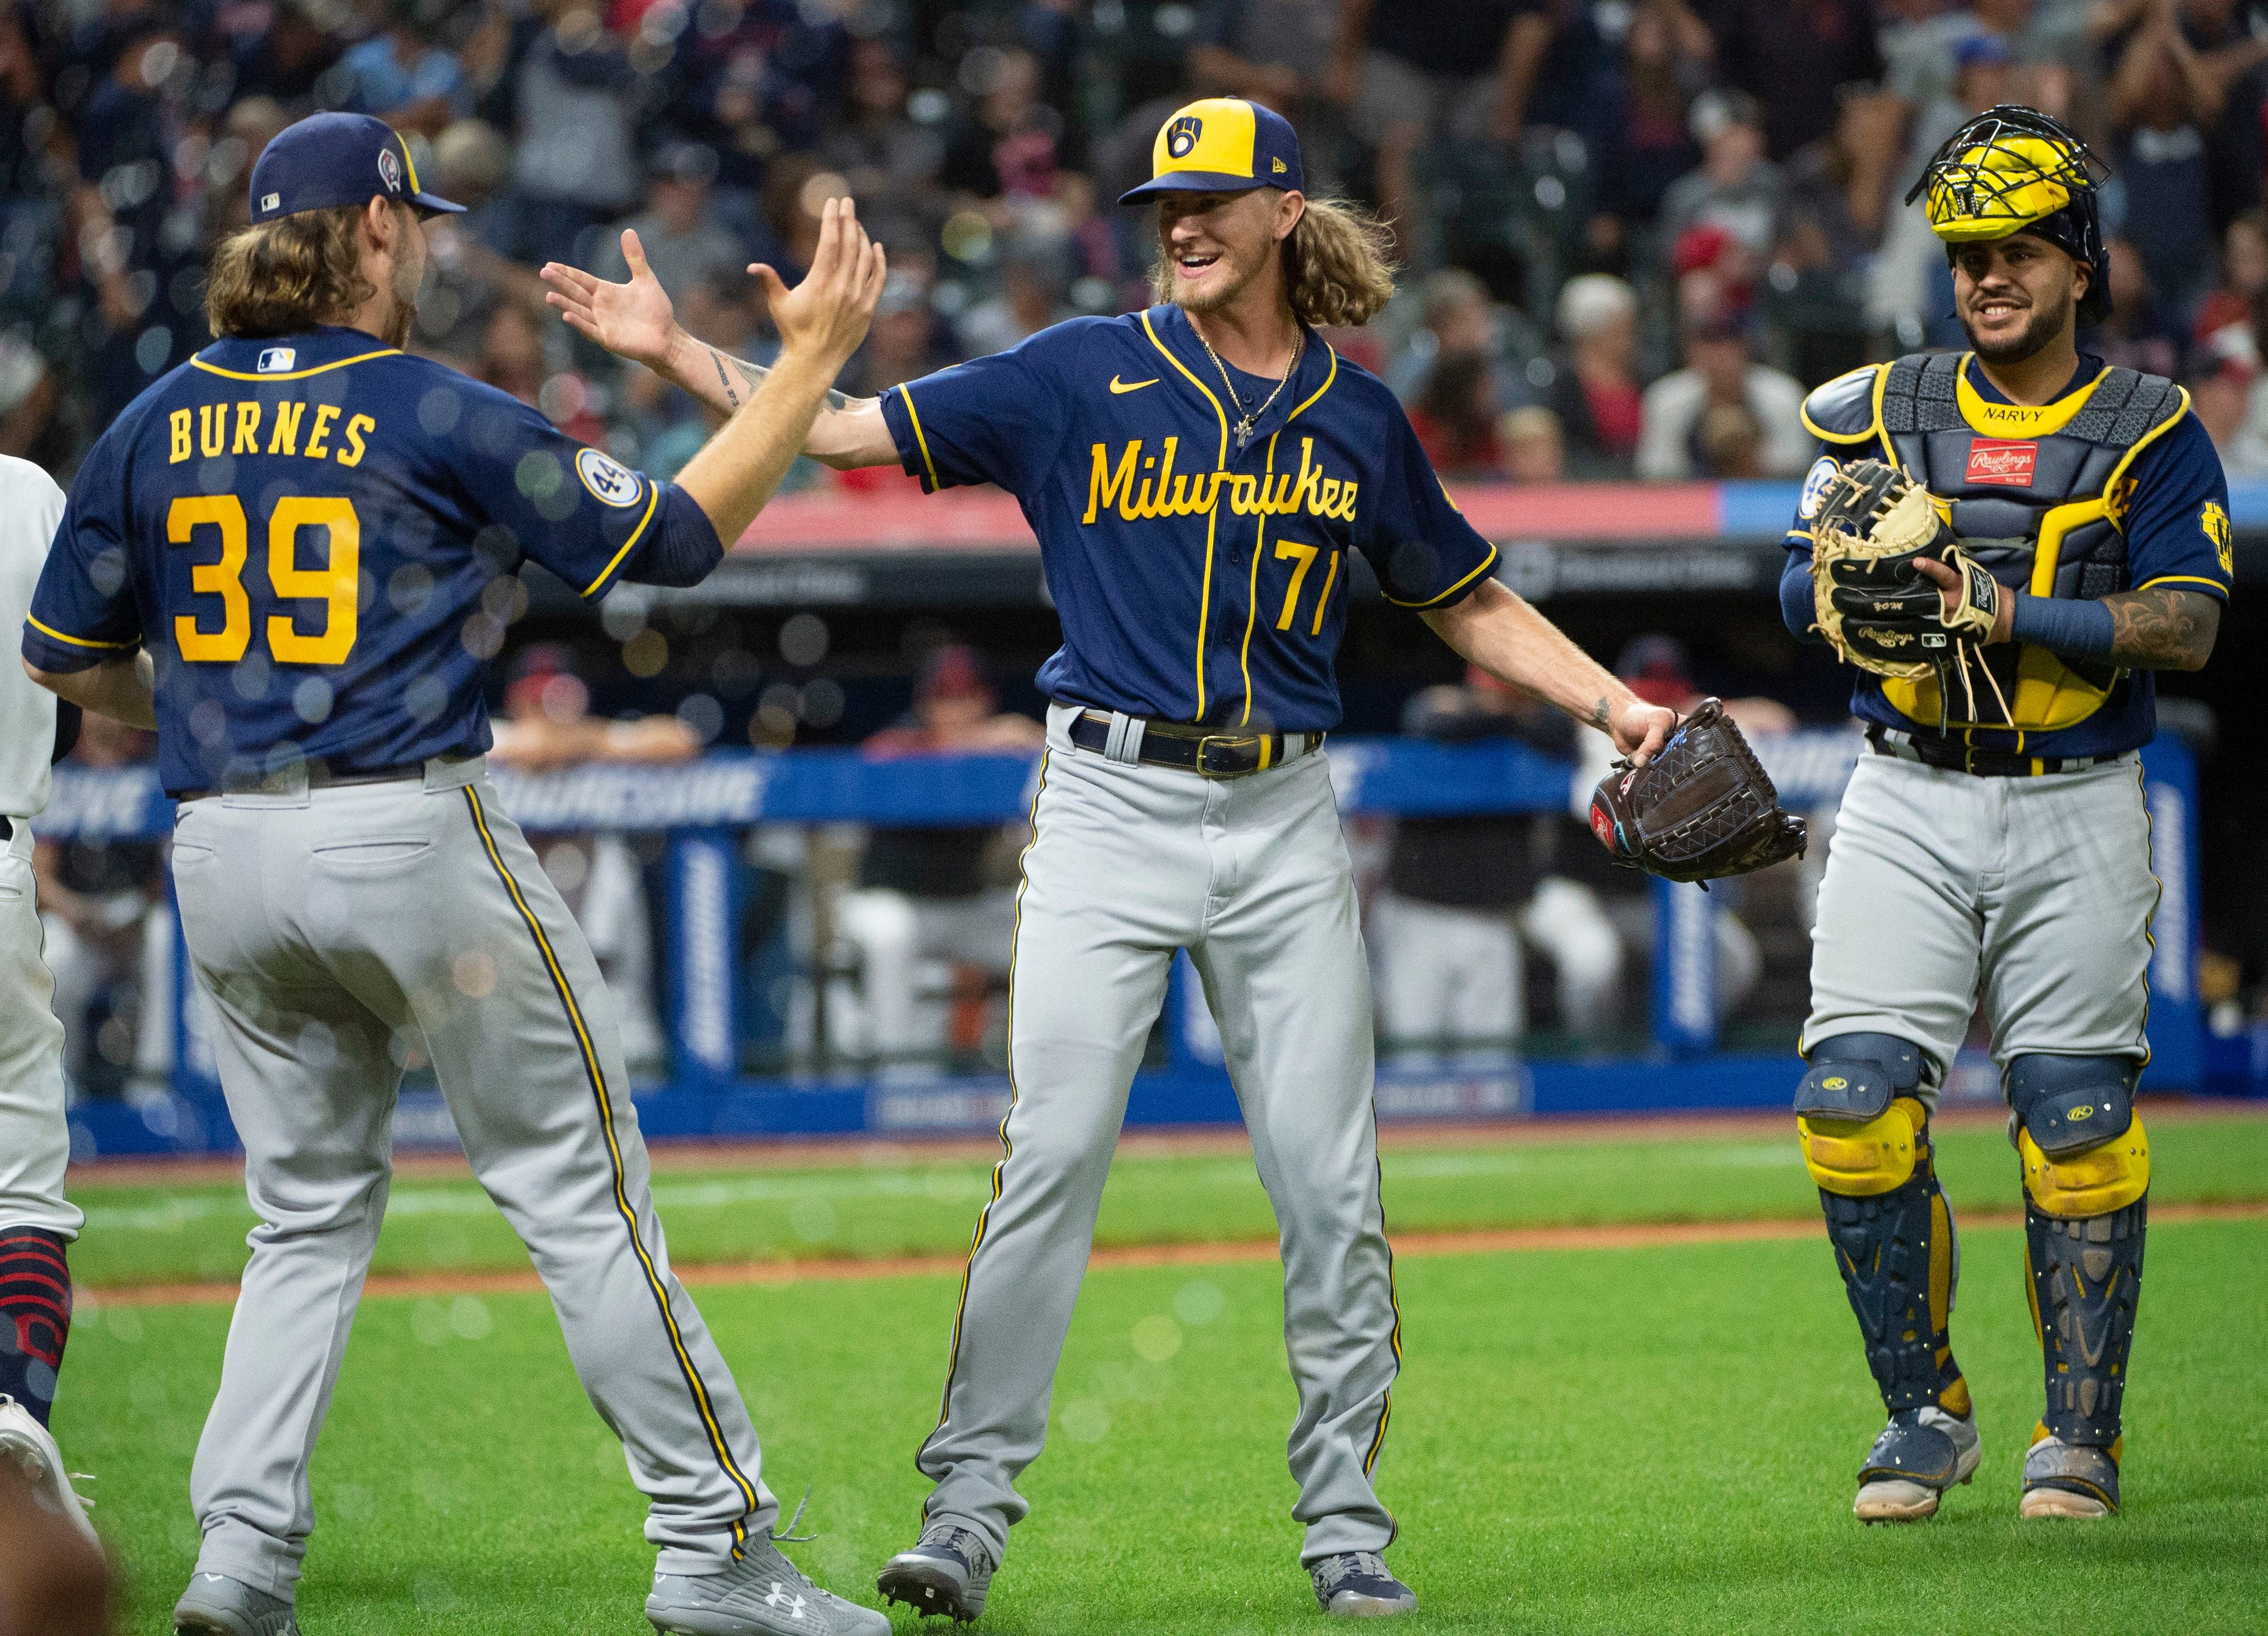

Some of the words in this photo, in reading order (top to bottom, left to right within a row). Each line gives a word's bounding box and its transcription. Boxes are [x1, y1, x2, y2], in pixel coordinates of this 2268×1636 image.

[169, 401, 376, 467] BURNES
[1983, 407, 2044, 421] NARVY
[592, 459, 625, 494] 44
[1082, 436, 1358, 525] Milwaukee
[1971, 450, 2031, 471] Rawlings
[166, 495, 360, 665] 39
[1274, 540, 1339, 636] 71
